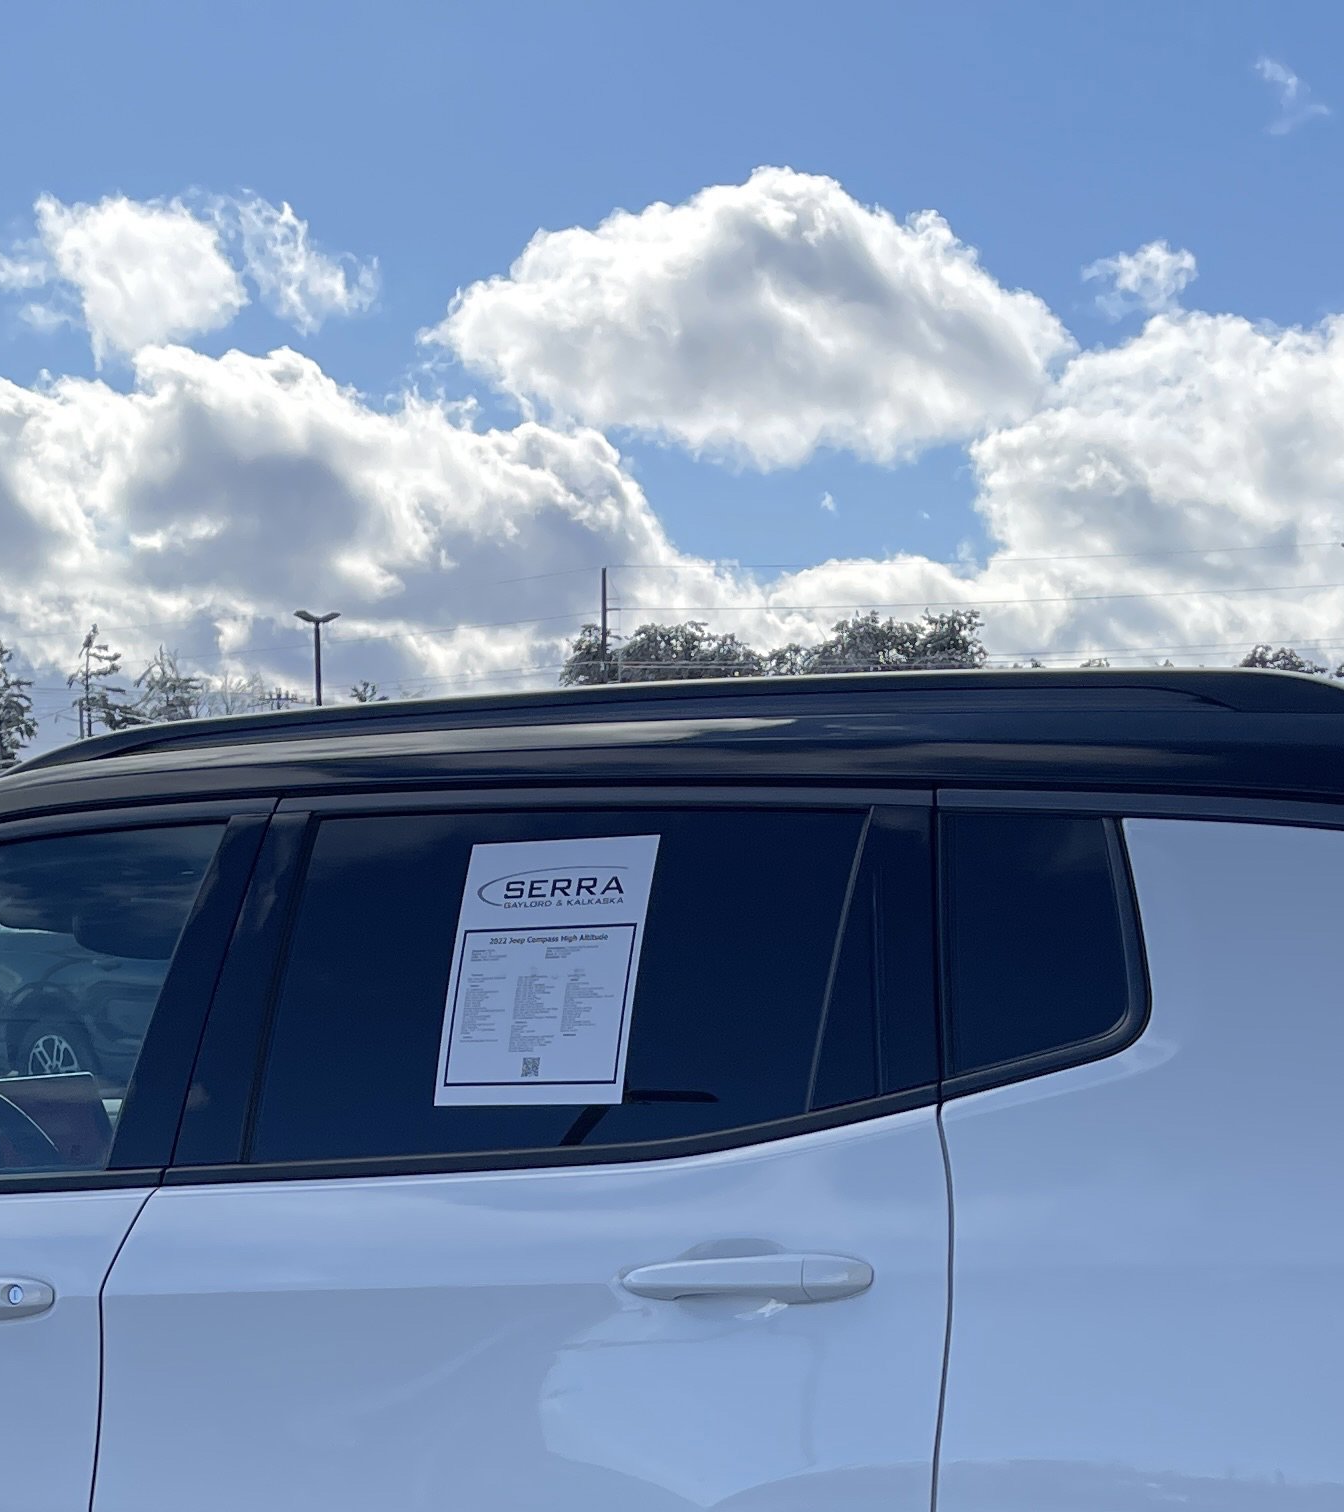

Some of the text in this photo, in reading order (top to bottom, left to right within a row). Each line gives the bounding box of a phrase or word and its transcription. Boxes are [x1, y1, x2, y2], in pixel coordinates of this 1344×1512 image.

[503, 876, 625, 900] SERRA
[503, 897, 625, 909] GAYLORD & KALKASKA
[508, 936, 526, 945] Jeep
[526, 935, 559, 945] Compass
[560, 934, 578, 943] High
[579, 932, 609, 942] Altitude
